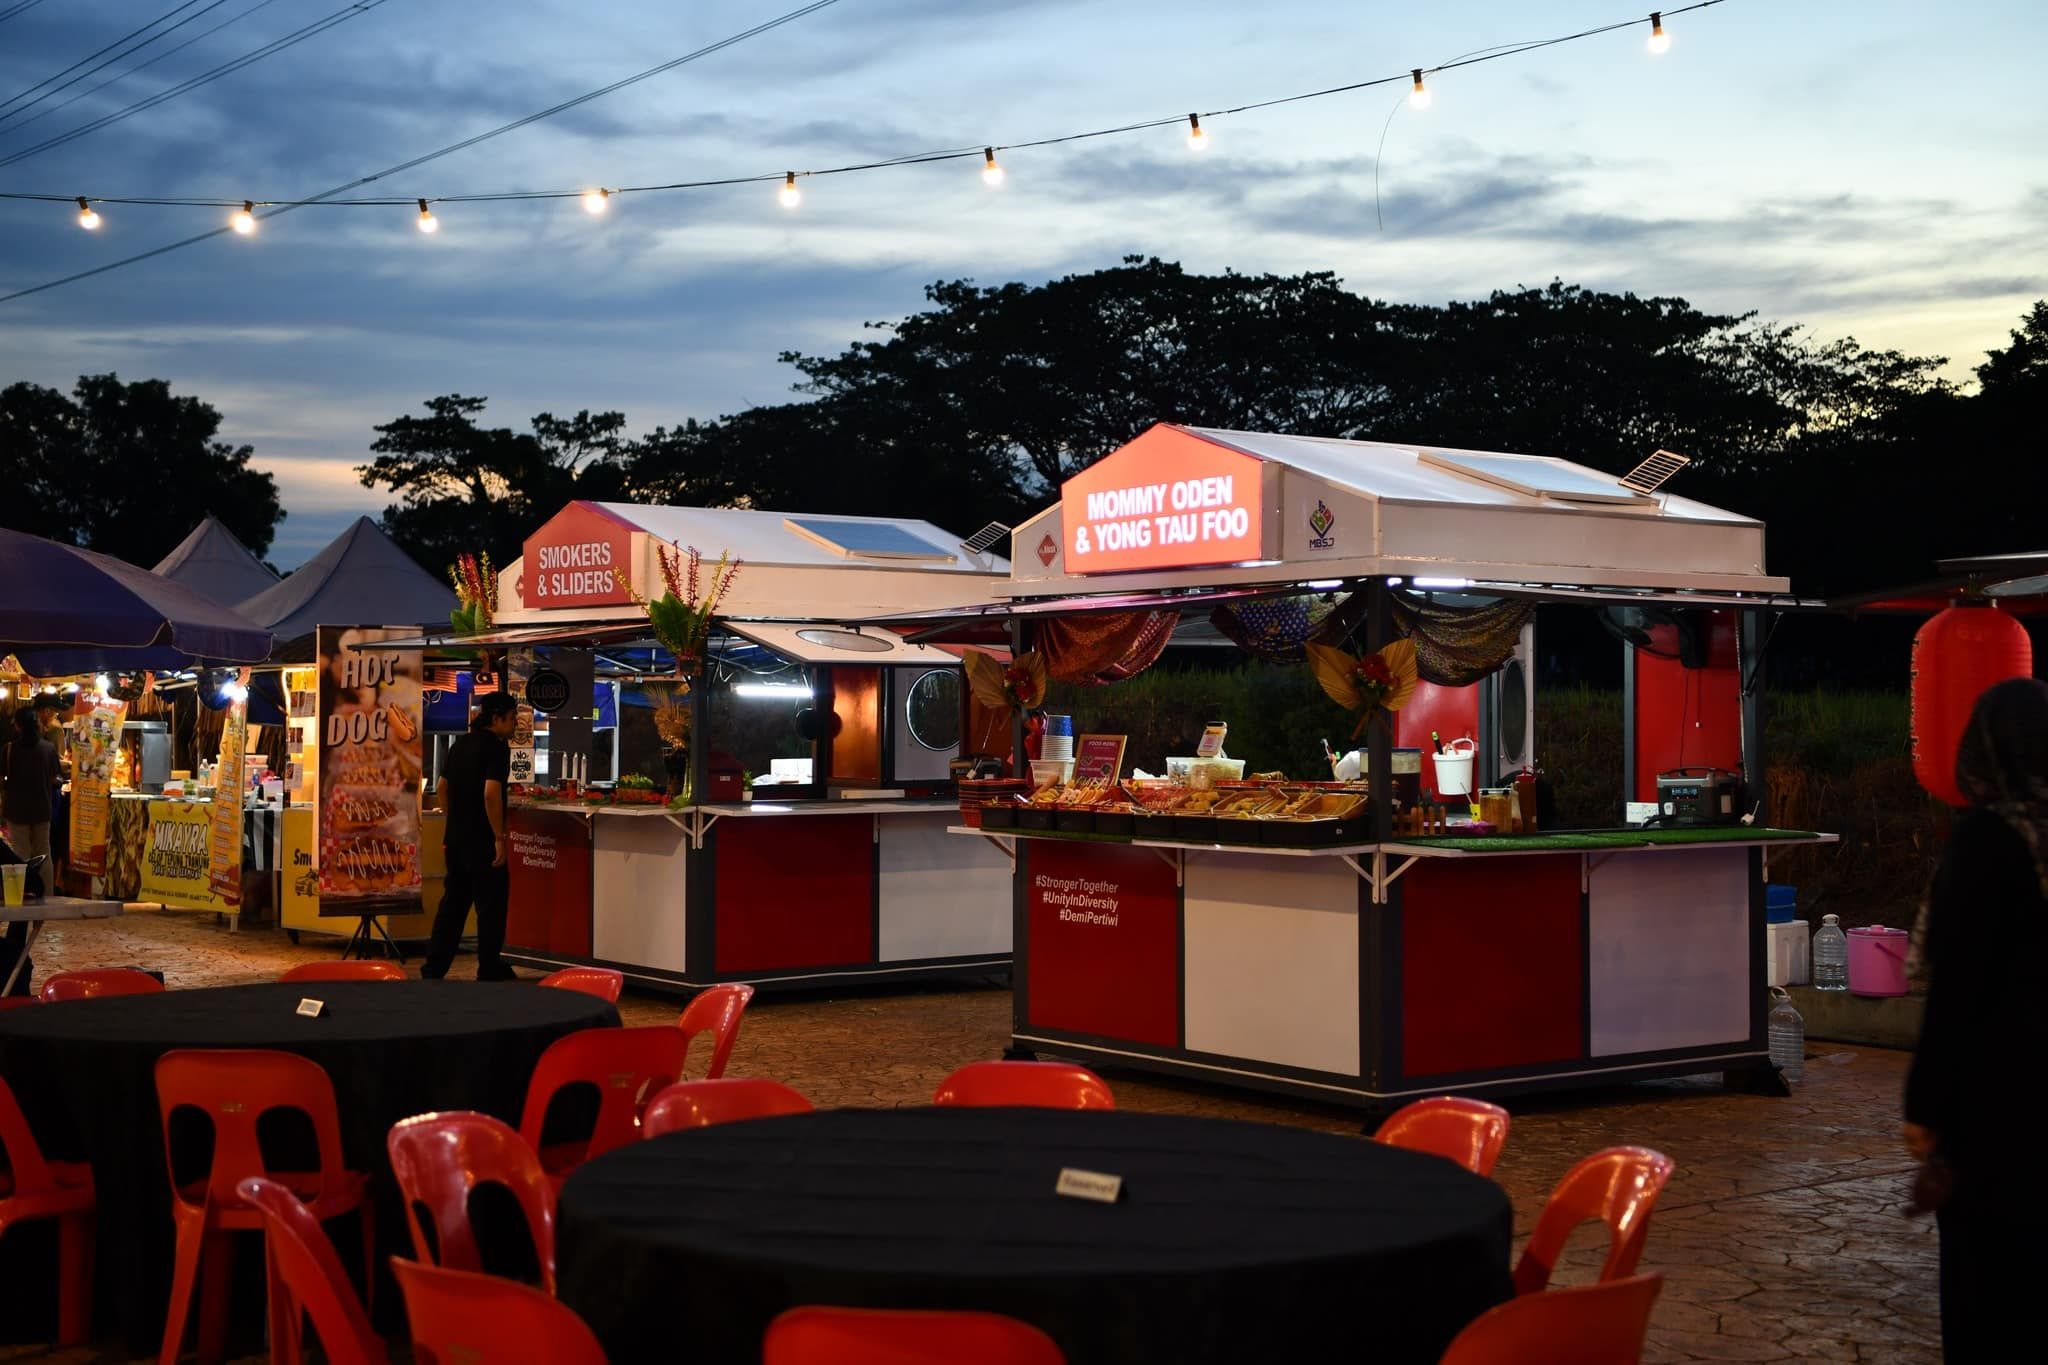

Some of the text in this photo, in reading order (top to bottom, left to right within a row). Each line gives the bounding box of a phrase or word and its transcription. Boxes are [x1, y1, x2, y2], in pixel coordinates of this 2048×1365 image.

[1087, 475, 1233, 521] MOMMY ODEN
[1075, 507, 1249, 554] & YONG TAU FOO
[1309, 538, 1335, 548] MBSJ
[539, 542, 611, 569] SMOKERS
[537, 570, 614, 597] & SLIDERS
[341, 652, 400, 689] HOT
[530, 684, 566, 699] CLOSED
[326, 708, 389, 748] DOG
[516, 750, 527, 760] NO
[153, 821, 208, 856] MIKAYRA
[1035, 874, 1119, 895] #StrongerTogether
[1043, 890, 1119, 913] #UnityInDiversity
[1059, 908, 1119, 927] #DemiPertiwi
